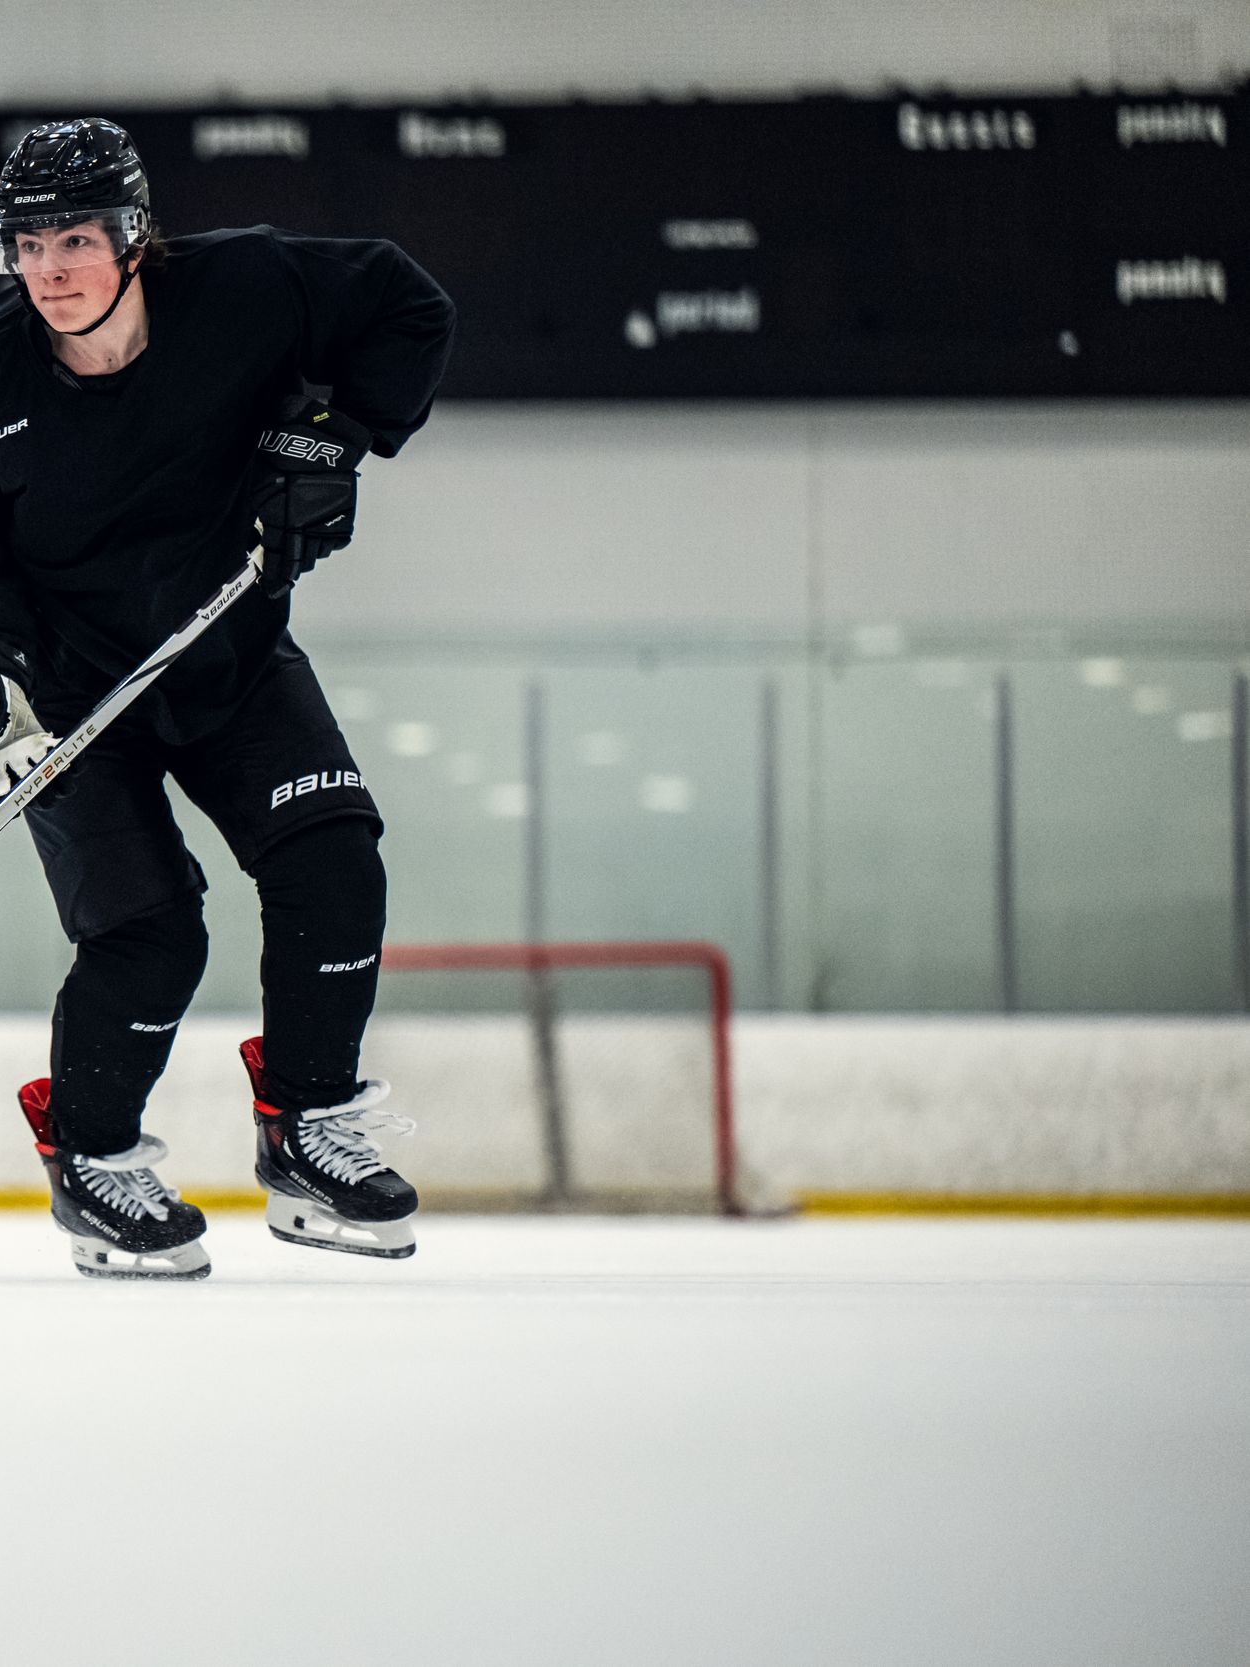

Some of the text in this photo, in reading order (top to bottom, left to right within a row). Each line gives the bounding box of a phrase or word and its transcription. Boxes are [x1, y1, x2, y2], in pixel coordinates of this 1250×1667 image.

[14, 193, 57, 204] BAUER
[258, 430, 344, 468] UER
[210, 581, 243, 616] BAUER
[14, 724, 97, 807] HYP2RLITE
[319, 953, 377, 973] BAUER
[290, 1171, 334, 1205] BAUER
[80, 1209, 122, 1241] BAUER
